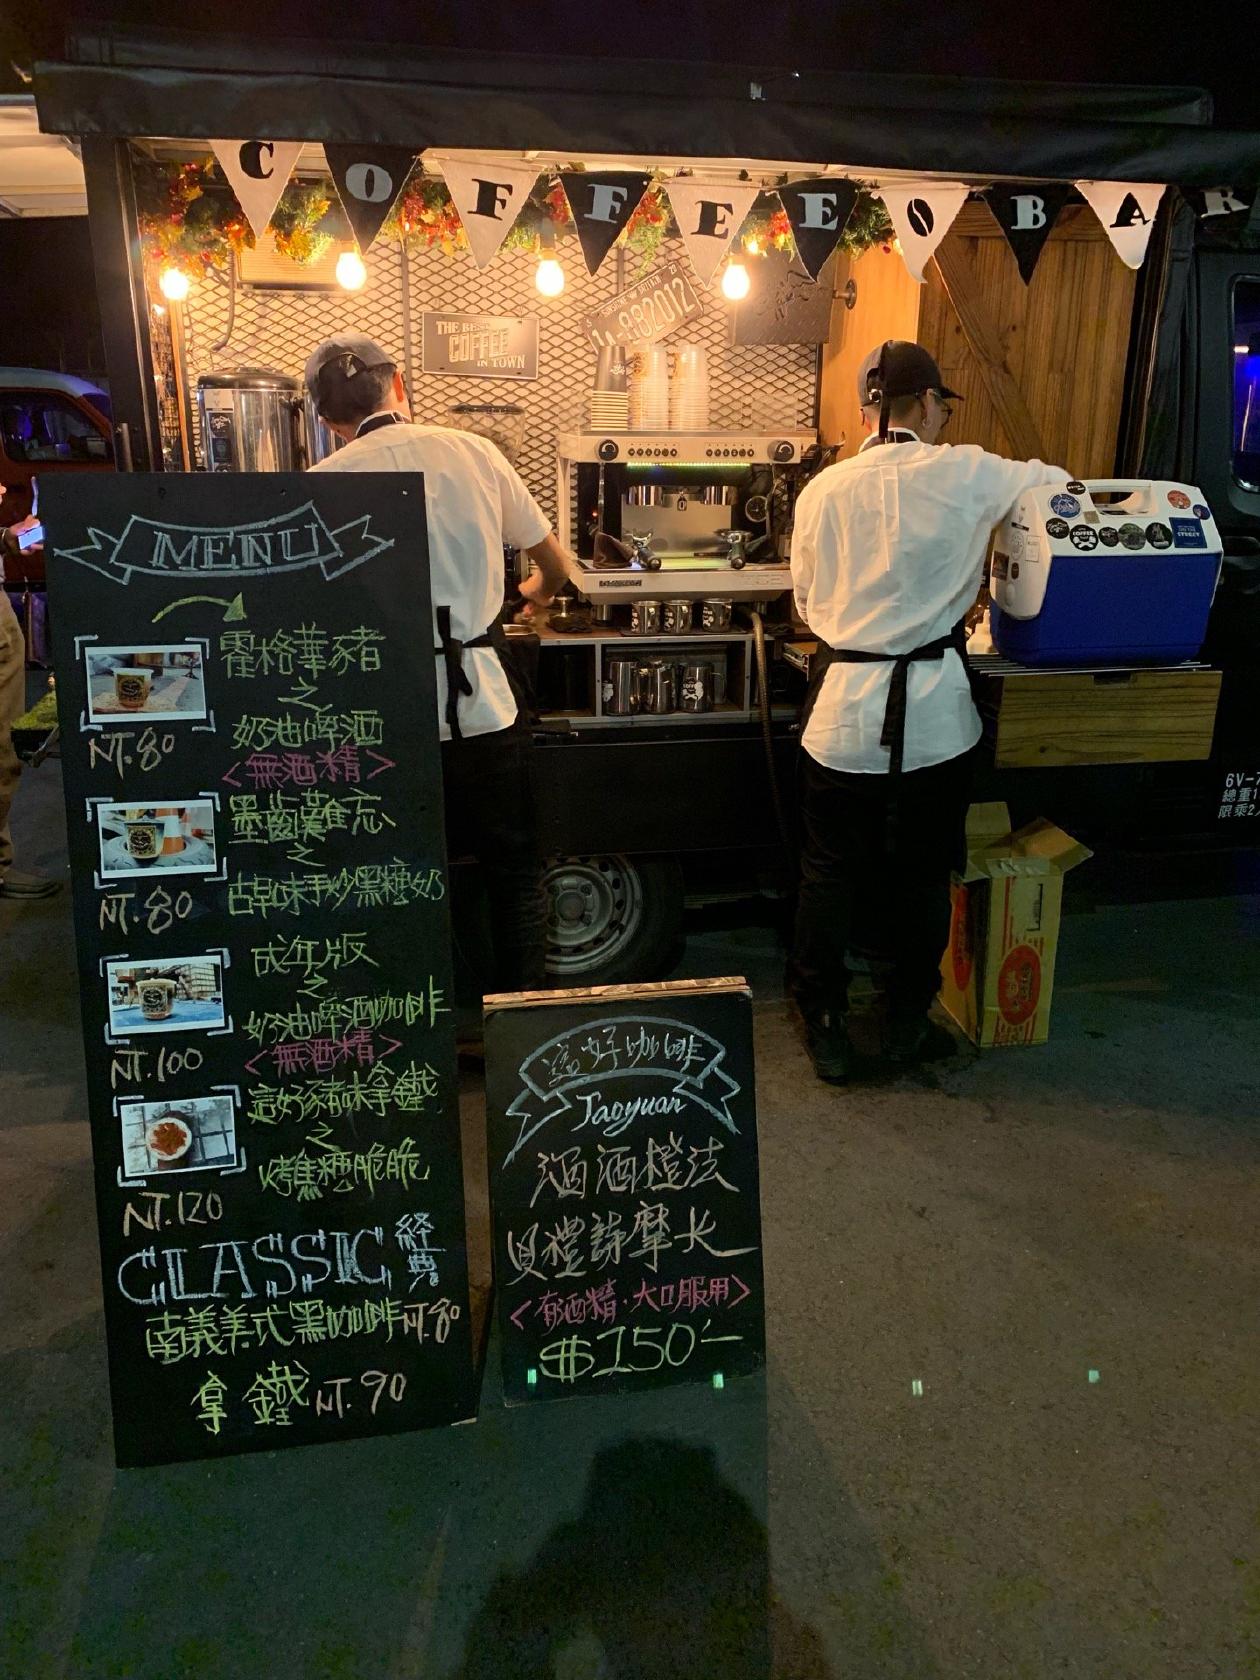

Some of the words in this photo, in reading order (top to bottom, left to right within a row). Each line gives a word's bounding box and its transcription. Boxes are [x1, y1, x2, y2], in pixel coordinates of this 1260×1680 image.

[436, 321, 460, 335] THE
[448, 328, 509, 363] COFFEE
[477, 359, 488, 367] IN
[493, 355, 525, 369] TOWN
[152, 523, 319, 570] MENU
[251, 932, 380, 977] 成年版
[571, 1091, 688, 1138] Taoyuan
[117, 1226, 392, 1305] CLASSIC
